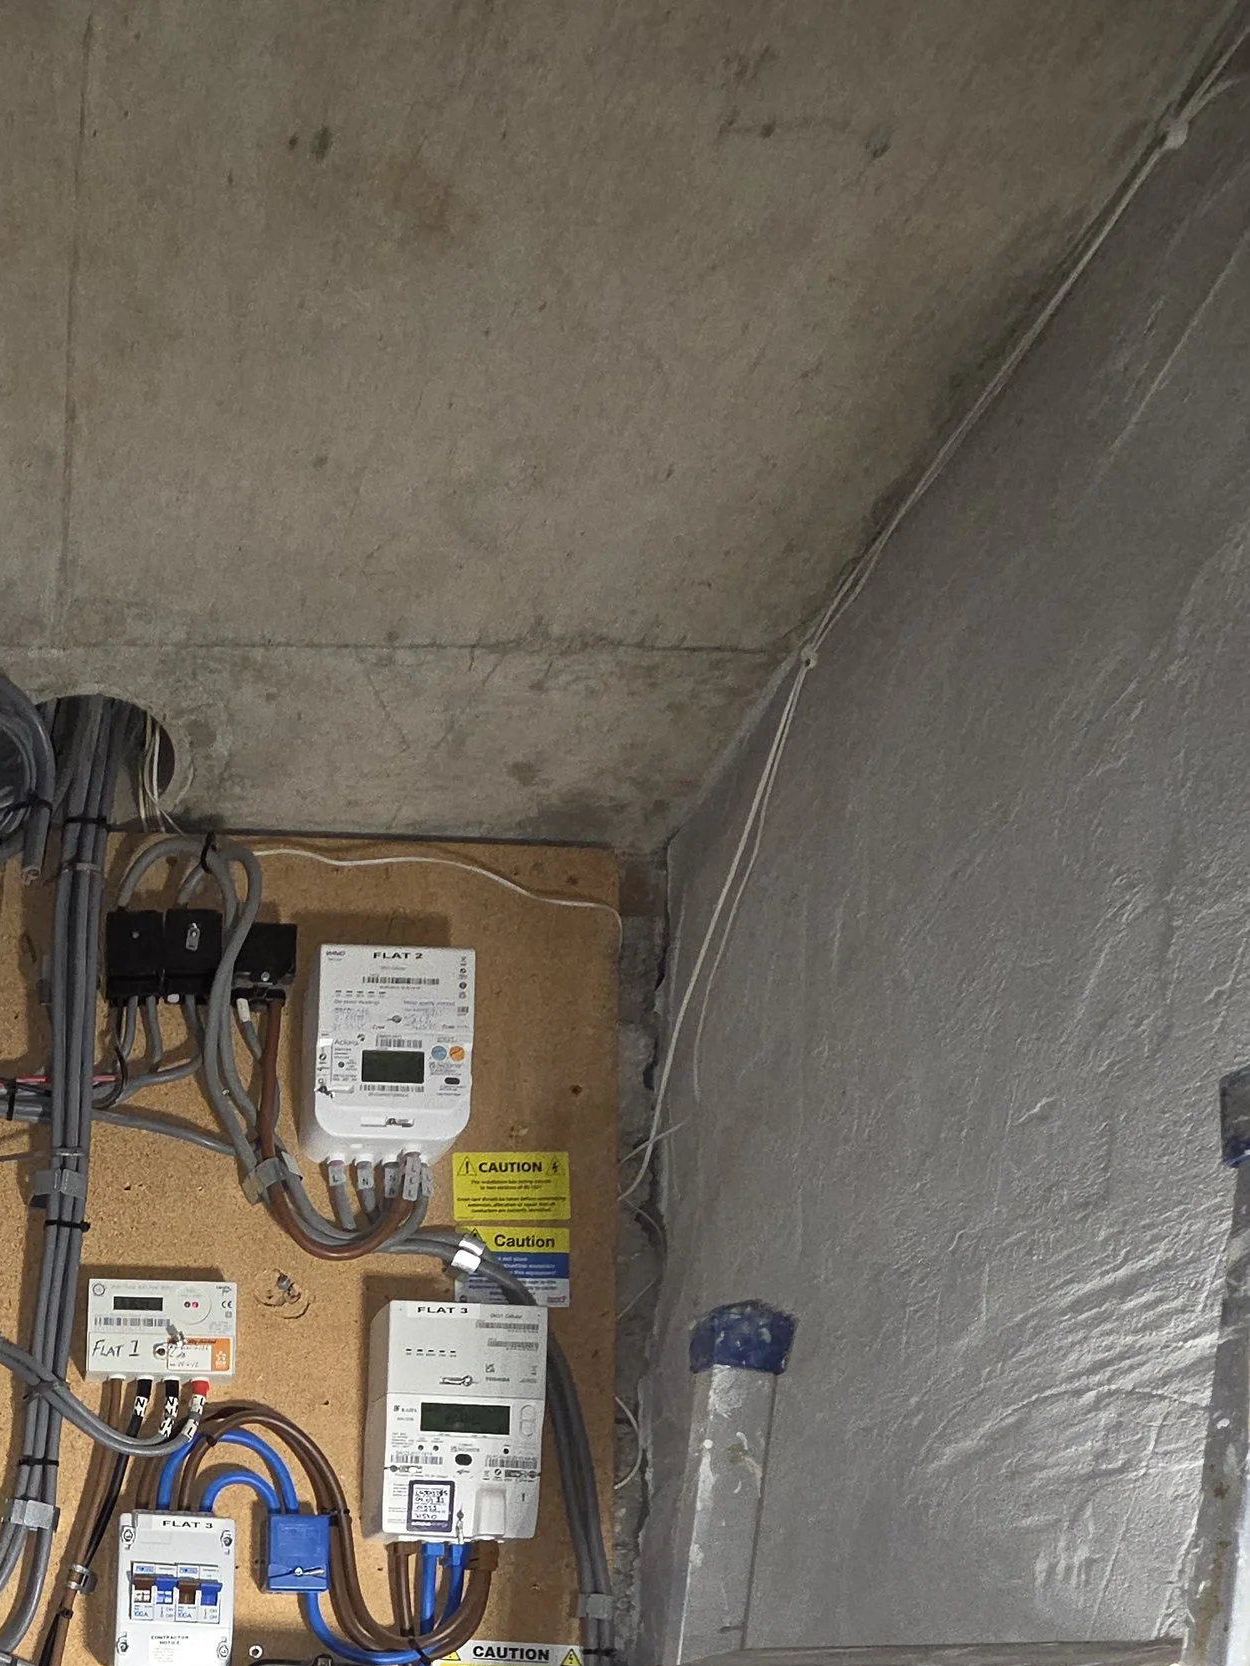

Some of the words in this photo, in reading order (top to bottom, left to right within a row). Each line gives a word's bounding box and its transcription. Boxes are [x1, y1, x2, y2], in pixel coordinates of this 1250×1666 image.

[415, 952, 423, 960] 2
[478, 1161, 543, 1173] CAUTION
[494, 1234, 555, 1248] Caution
[417, 1306, 456, 1314] FLAT
[91, 1339, 125, 1358] FLAT
[129, 1340, 140, 1357] 1
[162, 1520, 201, 1529] FLAT
[472, 1645, 550, 1662] CAUTION
